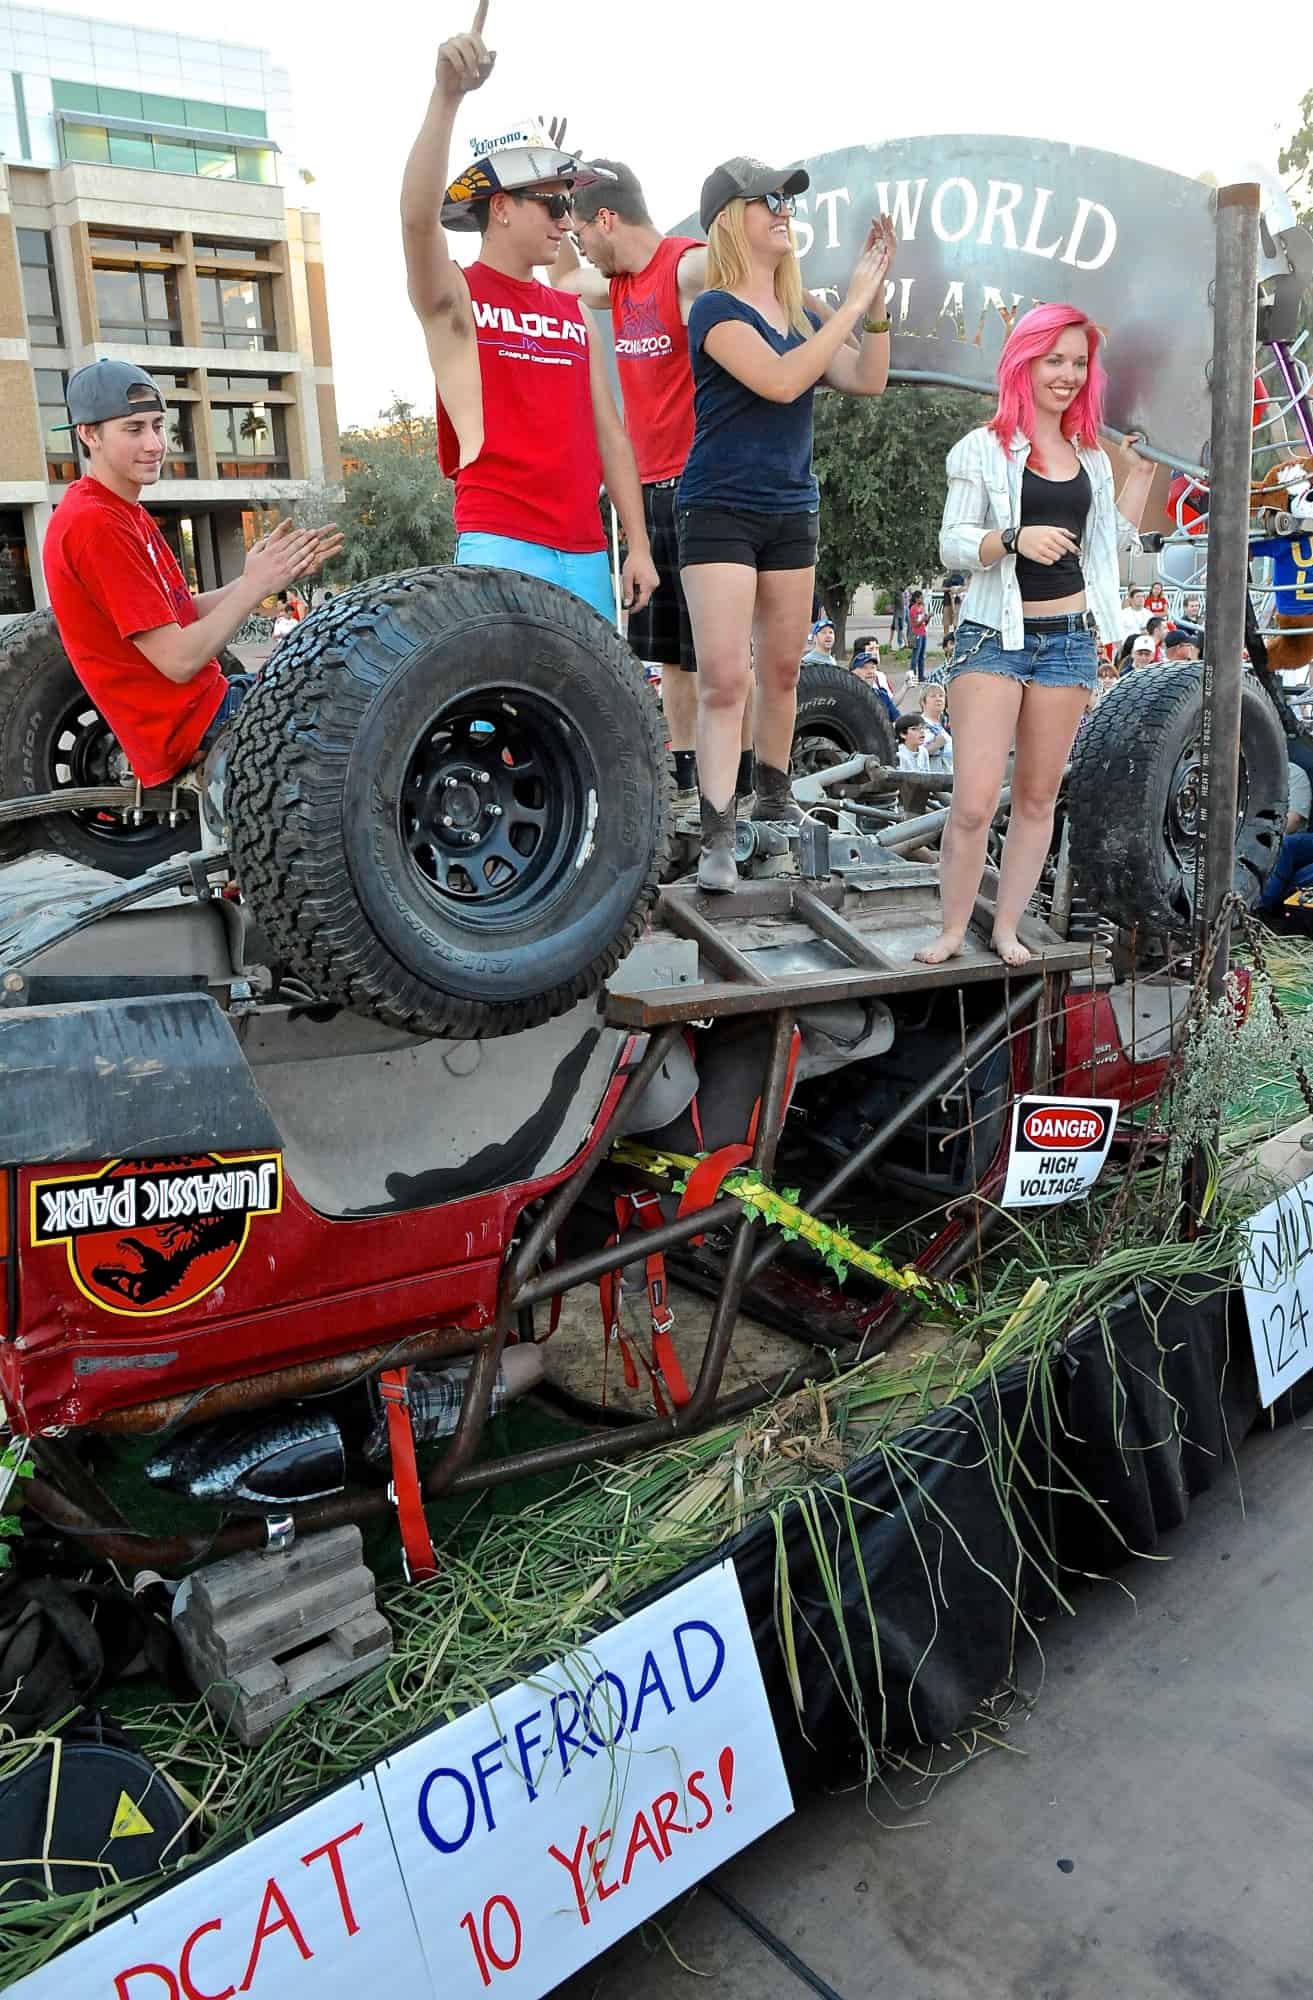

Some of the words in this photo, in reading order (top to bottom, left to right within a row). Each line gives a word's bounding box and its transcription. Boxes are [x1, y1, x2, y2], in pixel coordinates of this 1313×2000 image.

[875, 177, 1117, 270] WORLD
[472, 301, 587, 345] WILDCAT
[1030, 1118, 1097, 1138] DANGER
[141, 1162, 276, 1220] JURASSIC
[1020, 1176, 1085, 1197] VOLTAGE
[1039, 1156, 1079, 1174] HIGH
[41, 1178, 136, 1232] PARK
[418, 1620, 725, 1853] OFFROAD
[460, 1894, 522, 1986] 10
[547, 1746, 734, 1925] YEARS!
